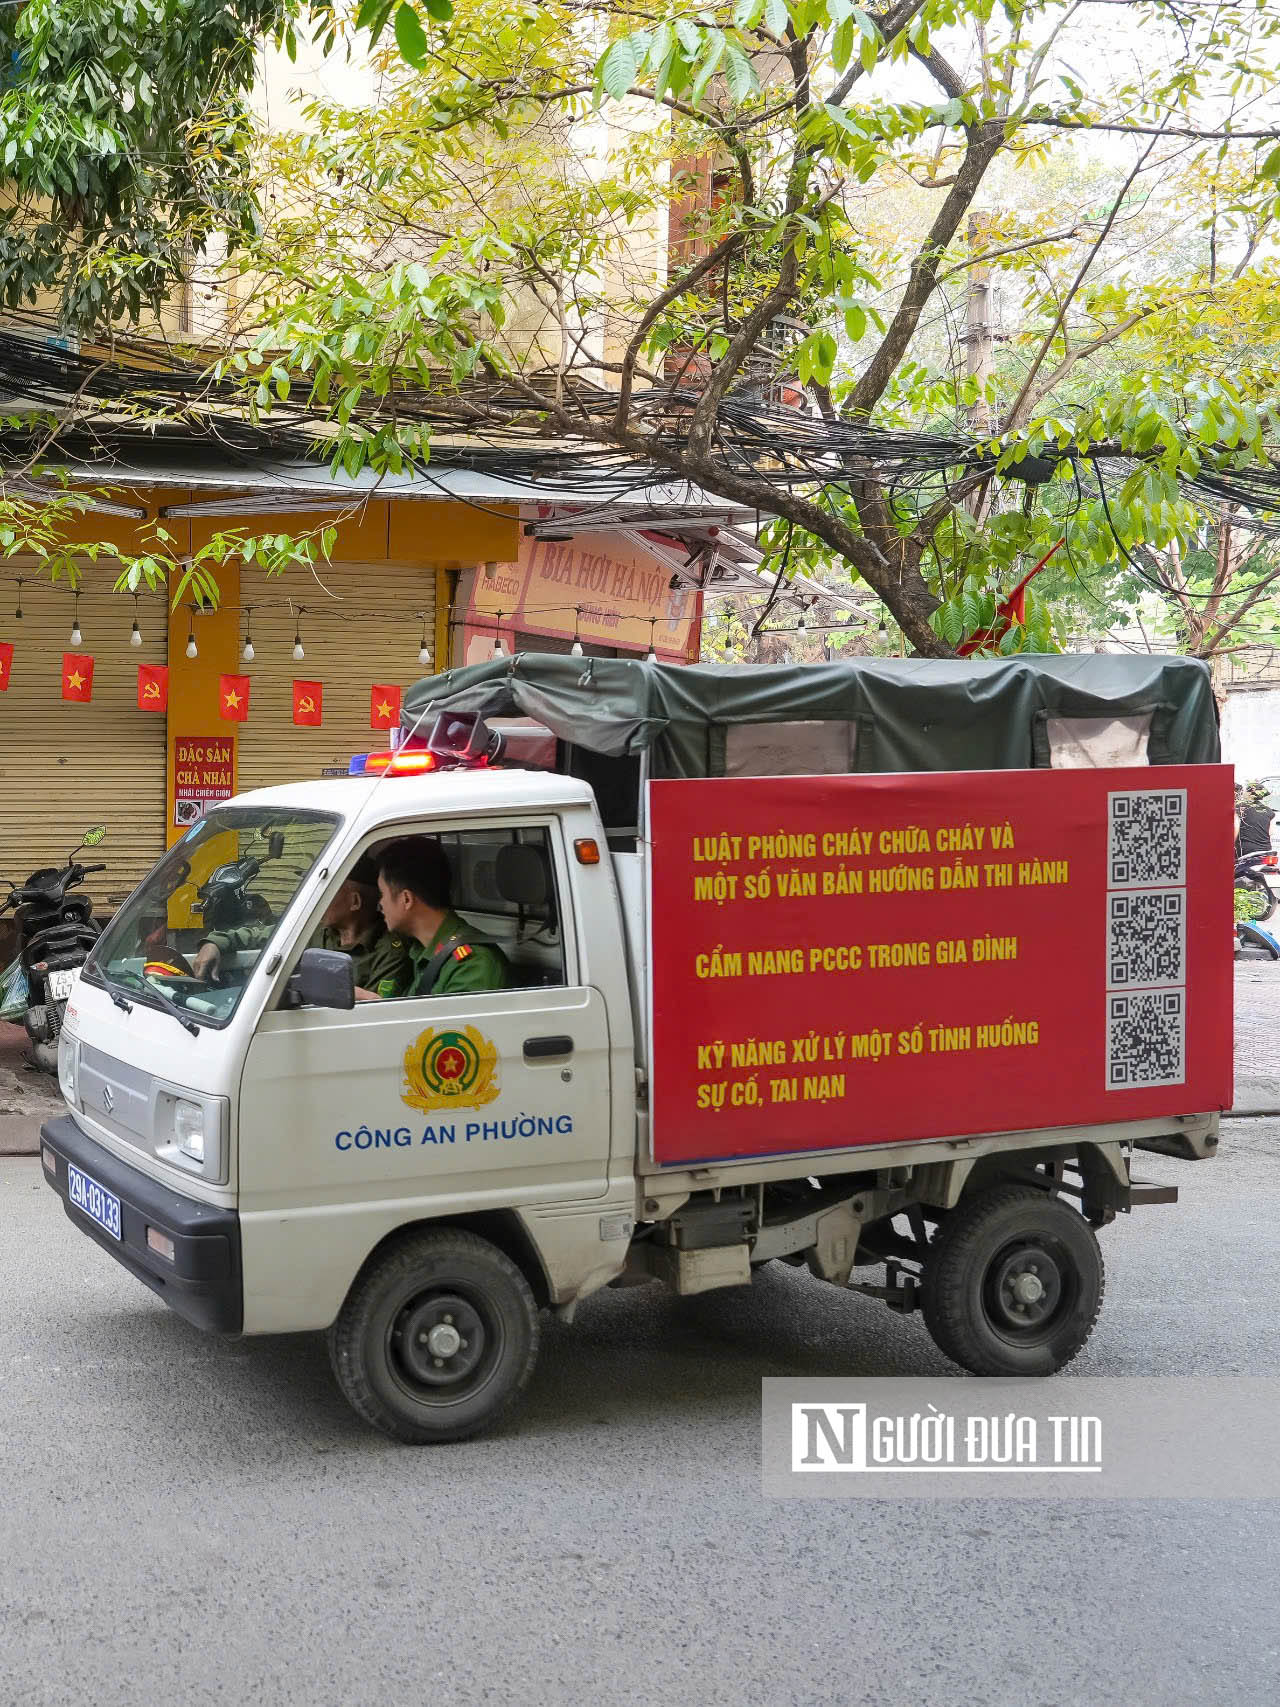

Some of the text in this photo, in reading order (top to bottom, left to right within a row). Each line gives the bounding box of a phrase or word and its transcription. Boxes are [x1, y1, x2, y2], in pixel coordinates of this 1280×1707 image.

[540, 543, 667, 612] BIA HƠI HÀ NỘI
[206, 742, 231, 762] SẢN
[177, 766, 231, 785] CHẢ NHÁI
[693, 821, 1016, 866] LUẬT PHÒNG CHÁY CHỮA CHÁY VÀ
[693, 857, 1070, 906] MỘT SỐ VĂN BẢN HƯỚNG DẪN THI HÀNH
[695, 933, 1017, 979] CẨM NANG PCCC TRONG GIA ĐÌNH
[697, 1015, 1040, 1070] KỸ NĂNG XỬ LÝ MỘT SỐ TÌNH HUỐNG
[696, 1072, 846, 1112] SỰ CỐ, TAI NẠN
[335, 1112, 573, 1151] CÔNG AN PHƯỜNG
[70, 1169, 119, 1233] 29A-031.33
